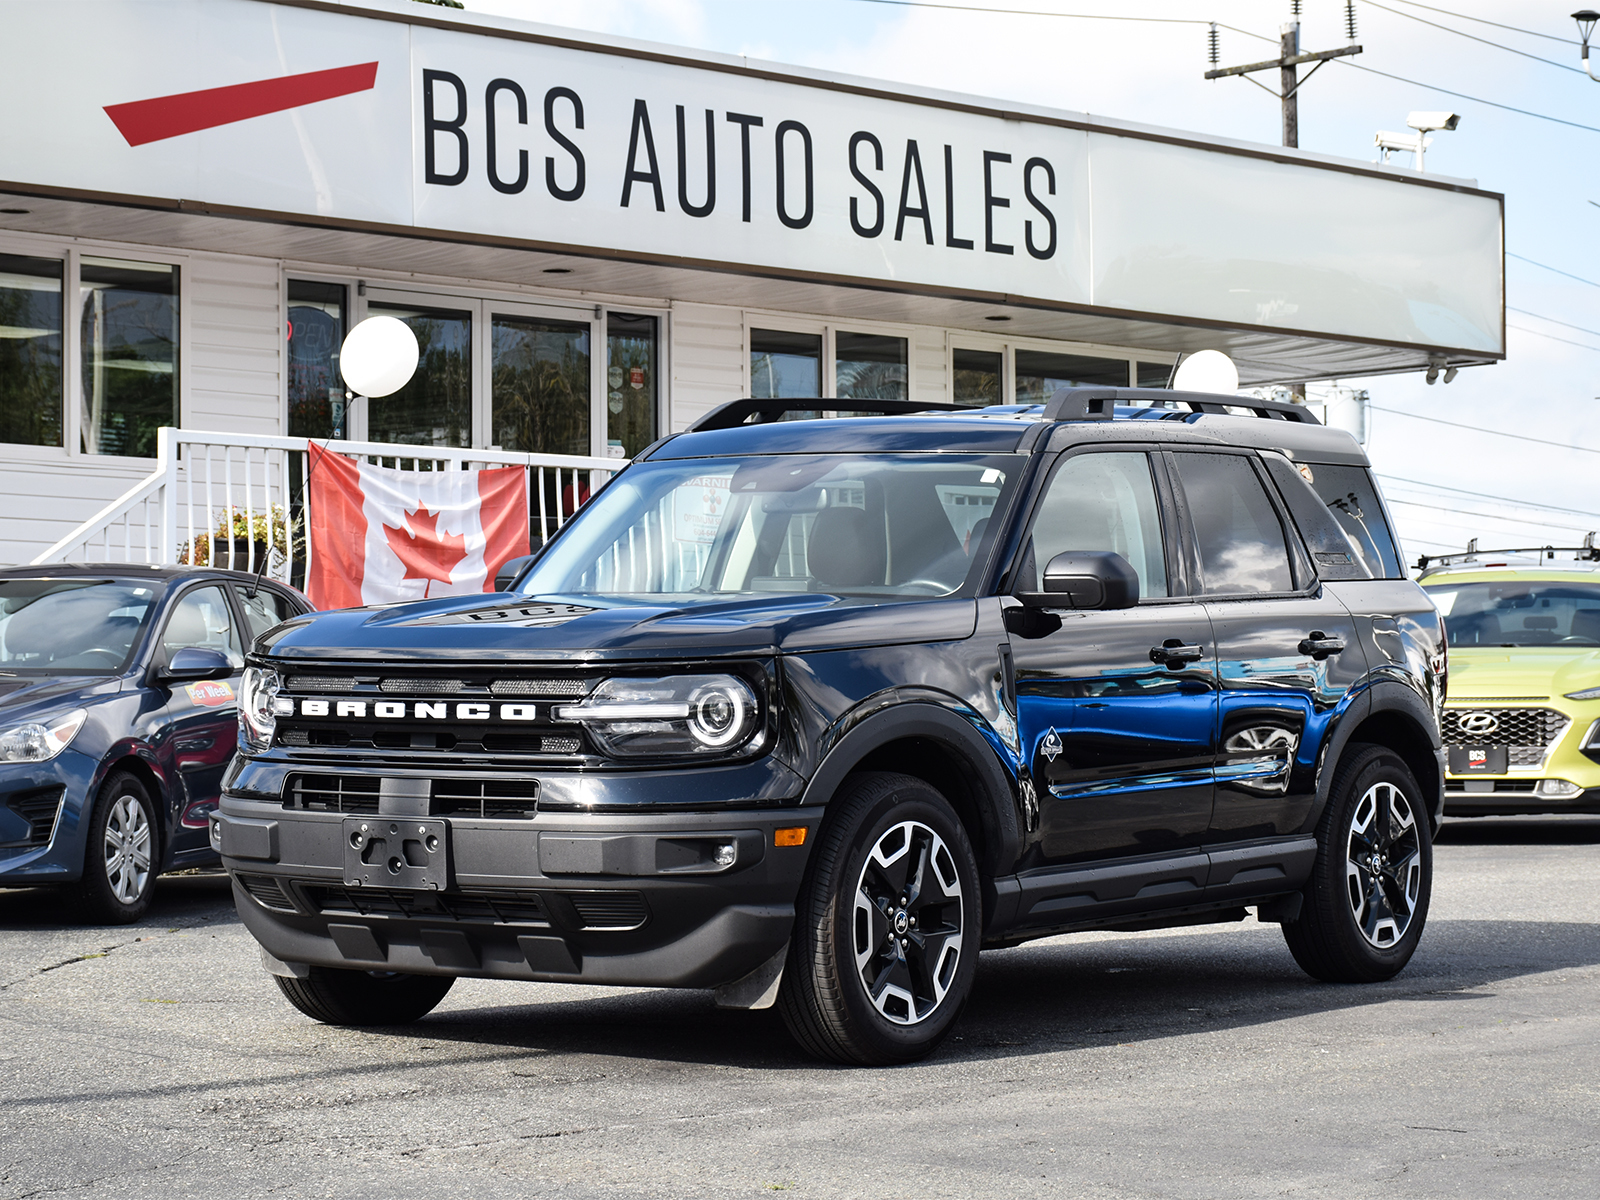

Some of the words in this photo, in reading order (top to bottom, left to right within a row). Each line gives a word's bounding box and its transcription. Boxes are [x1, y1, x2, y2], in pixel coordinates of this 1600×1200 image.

[422, 68, 586, 202] BCS
[620, 98, 814, 230] AUTO
[848, 130, 1057, 261] SALES
[681, 478, 731, 488] WARNI
[188, 687, 206, 700] Per
[204, 684, 232, 698] Week
[301, 700, 536, 721] BRONCO
[1469, 750, 1486, 761] BCS
